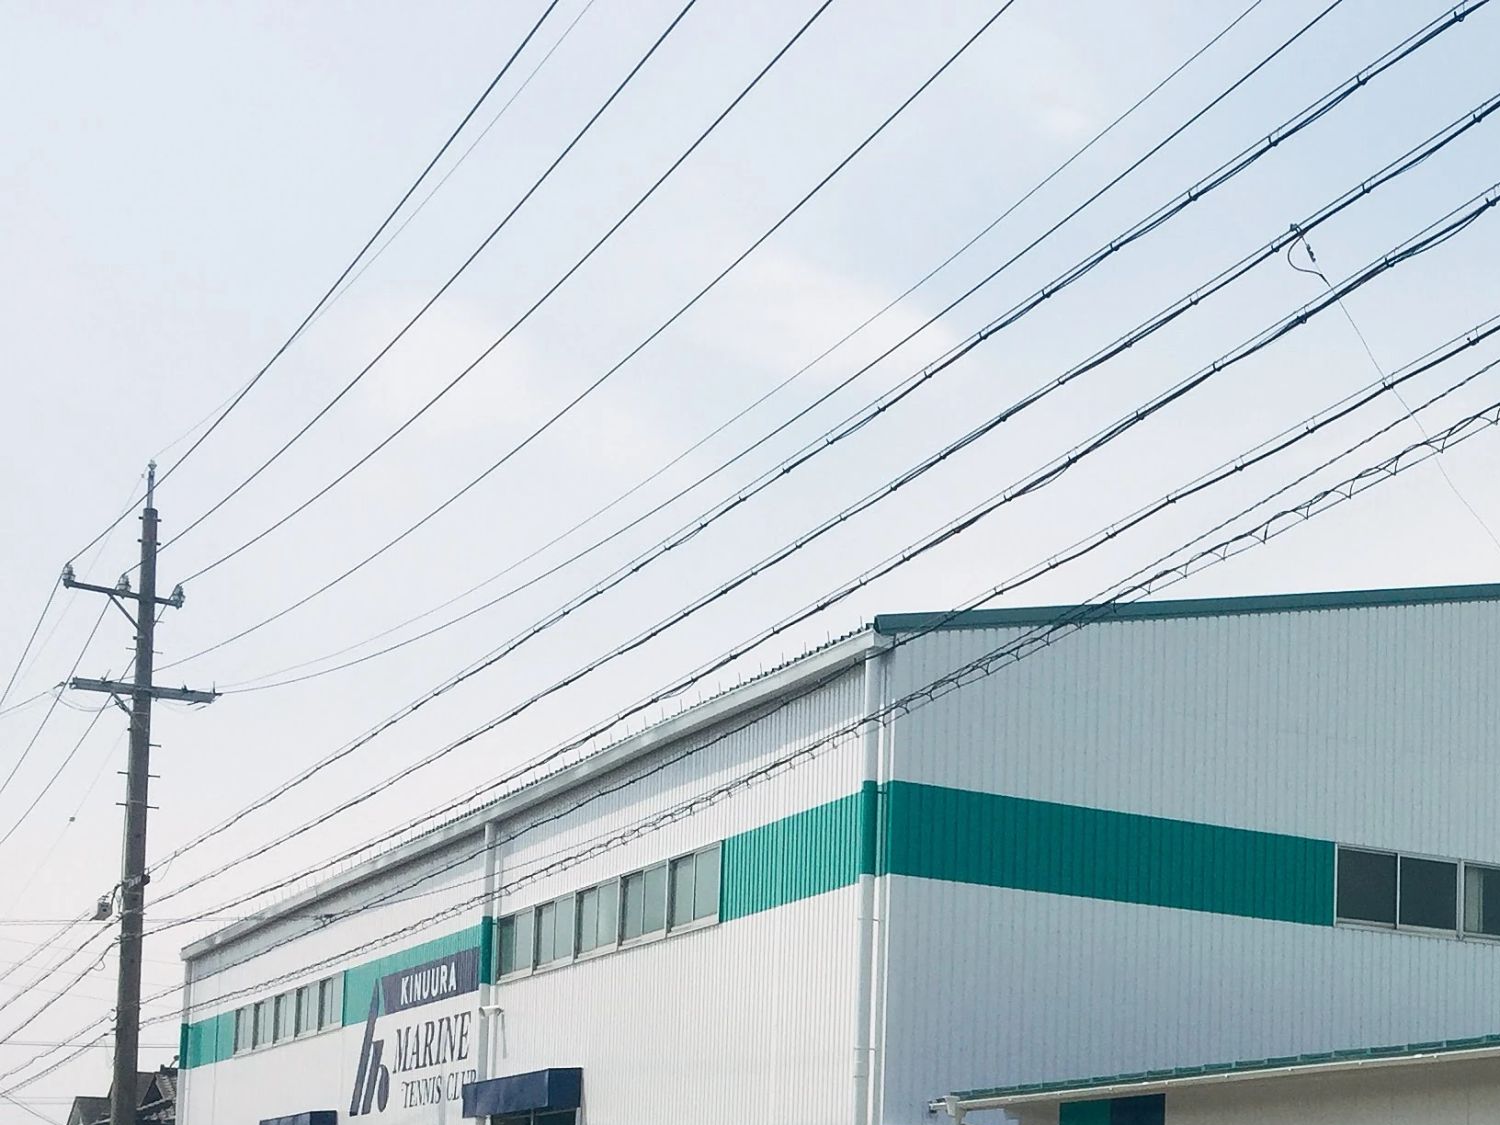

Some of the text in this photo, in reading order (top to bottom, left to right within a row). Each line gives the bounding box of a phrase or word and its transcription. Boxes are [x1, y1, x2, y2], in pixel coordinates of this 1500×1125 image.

[400, 962, 457, 1006] KINUURA
[392, 1011, 472, 1074] MARINE
[401, 1074, 442, 1109] TENNIS
